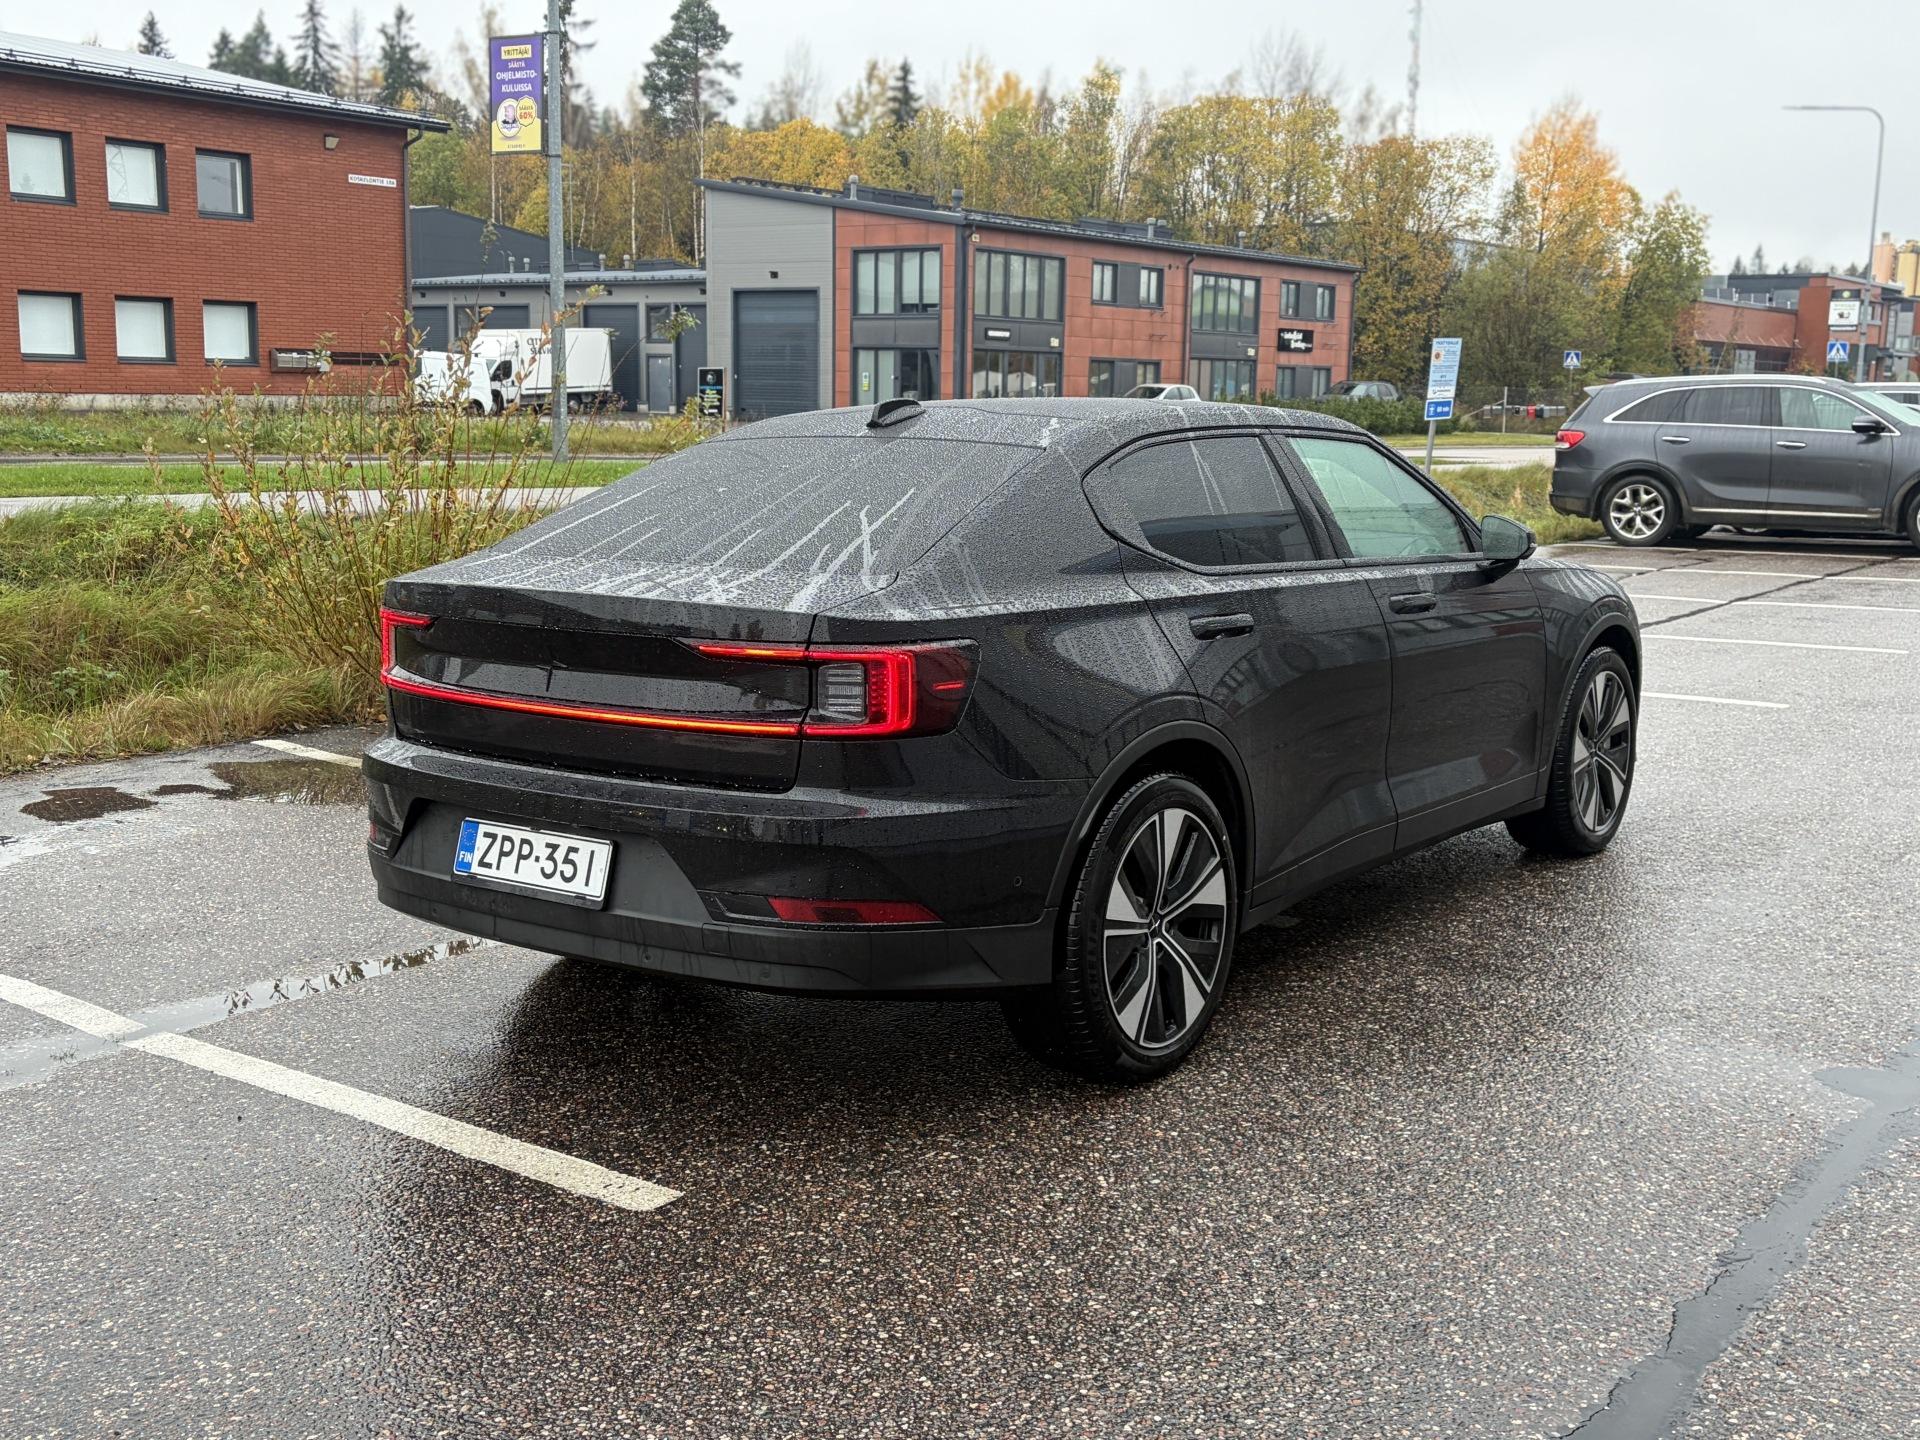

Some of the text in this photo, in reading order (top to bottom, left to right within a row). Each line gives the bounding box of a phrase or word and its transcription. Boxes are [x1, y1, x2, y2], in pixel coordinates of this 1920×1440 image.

[503, 48, 530, 57] YRITTÄJÄ!
[508, 61, 525, 69] SÄÄSTÄ
[496, 70, 537, 81] OHJELMISTO-
[502, 83, 532, 92] KULUISSA
[459, 850, 473, 863] FIN
[477, 831, 595, 887] ZPP-351
